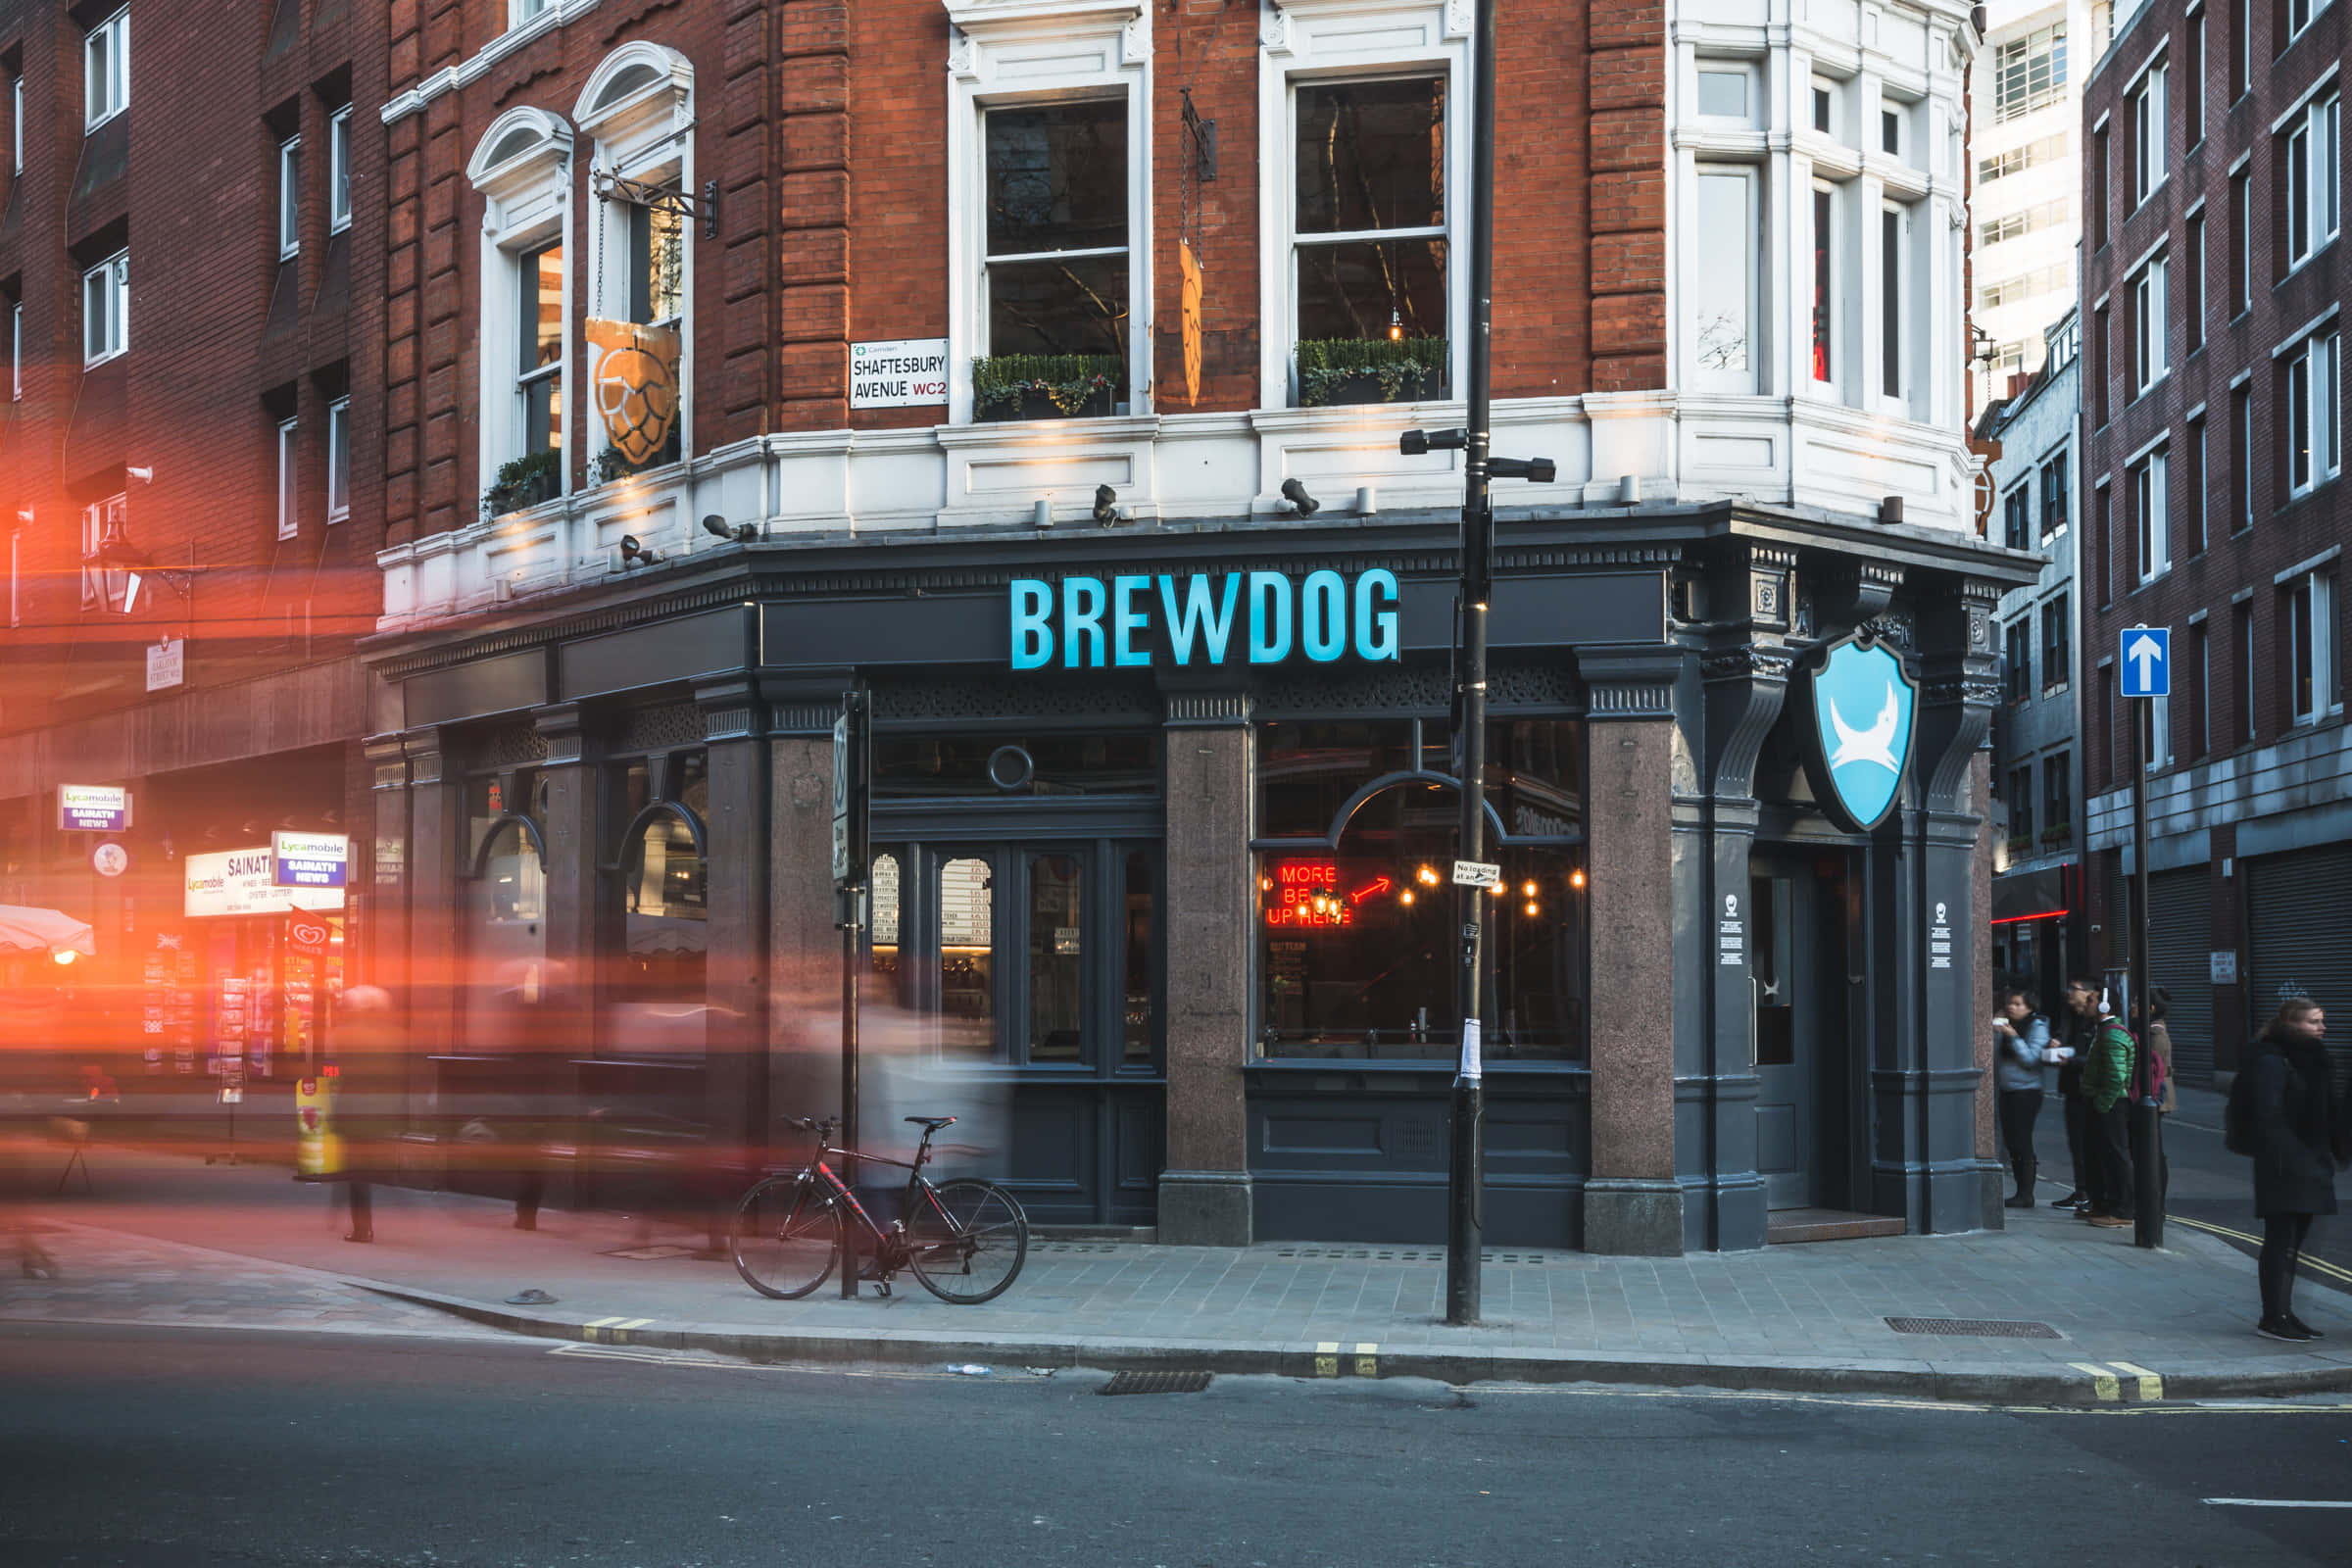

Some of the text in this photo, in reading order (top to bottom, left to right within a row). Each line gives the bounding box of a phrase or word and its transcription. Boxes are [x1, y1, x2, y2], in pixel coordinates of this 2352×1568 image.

[854, 356, 945, 375] SHAFTESBURY
[855, 380, 947, 398] AVENUE WC2
[1010, 568, 1400, 669] BREWDOG
[66, 792, 122, 803] Lycamobile
[72, 808, 116, 819] SAINATH
[79, 819, 109, 828] NEWS
[281, 841, 344, 853] Lycamobile
[288, 860, 337, 872] SAINATH
[1470, 865, 1496, 875] loading
[295, 872, 329, 884] NEWS
[1282, 866, 1337, 882] MORE
[187, 874, 224, 892] Lycamobile
[1269, 908, 1294, 924] UP
